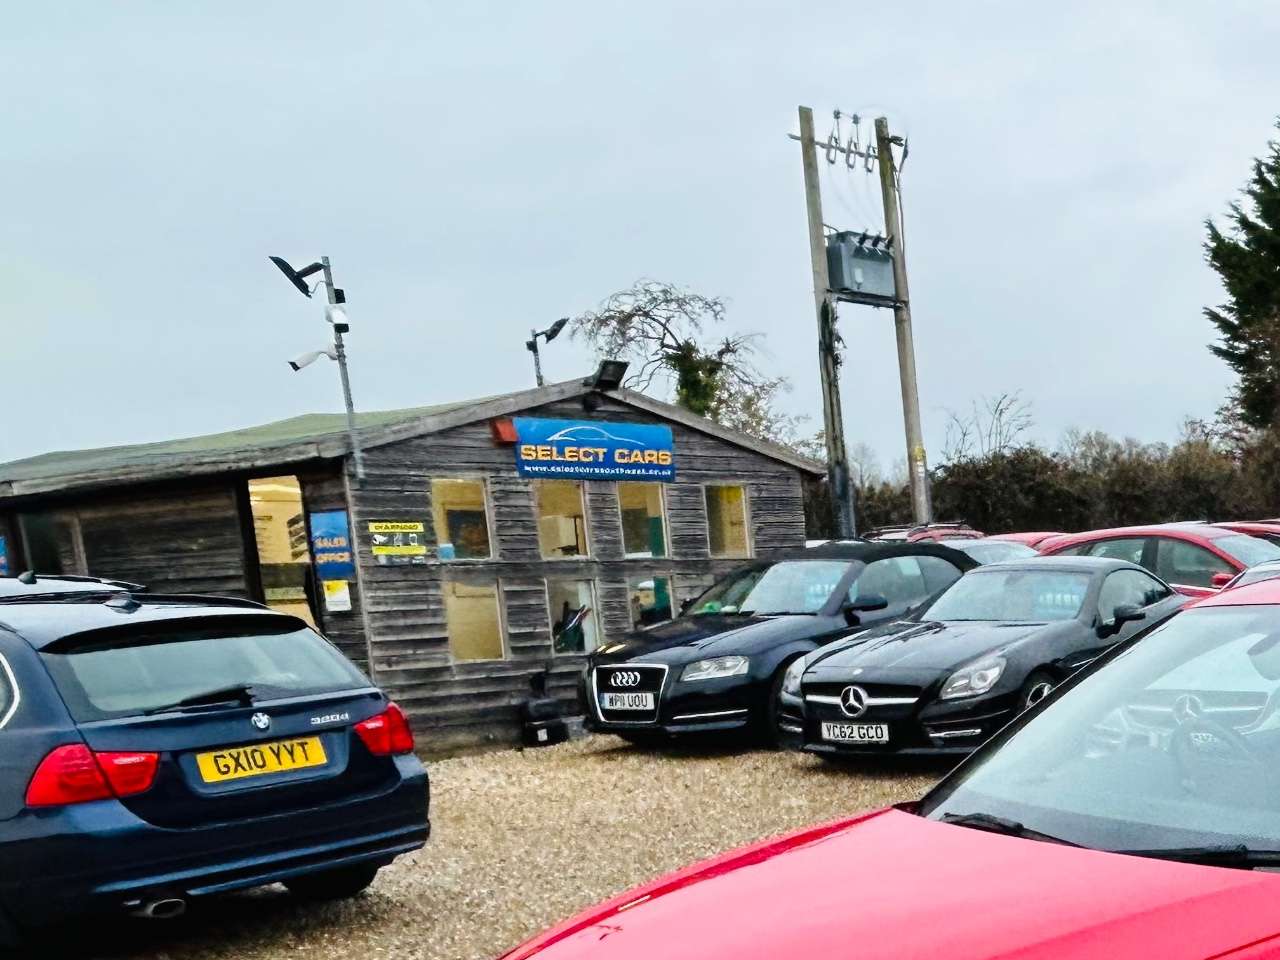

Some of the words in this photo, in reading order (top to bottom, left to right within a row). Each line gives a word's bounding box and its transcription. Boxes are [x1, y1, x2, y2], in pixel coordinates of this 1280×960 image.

[520, 444, 608, 462] SELECT
[614, 449, 673, 465] CARS
[213, 748, 267, 776] GX10
[269, 741, 310, 766] YYT
